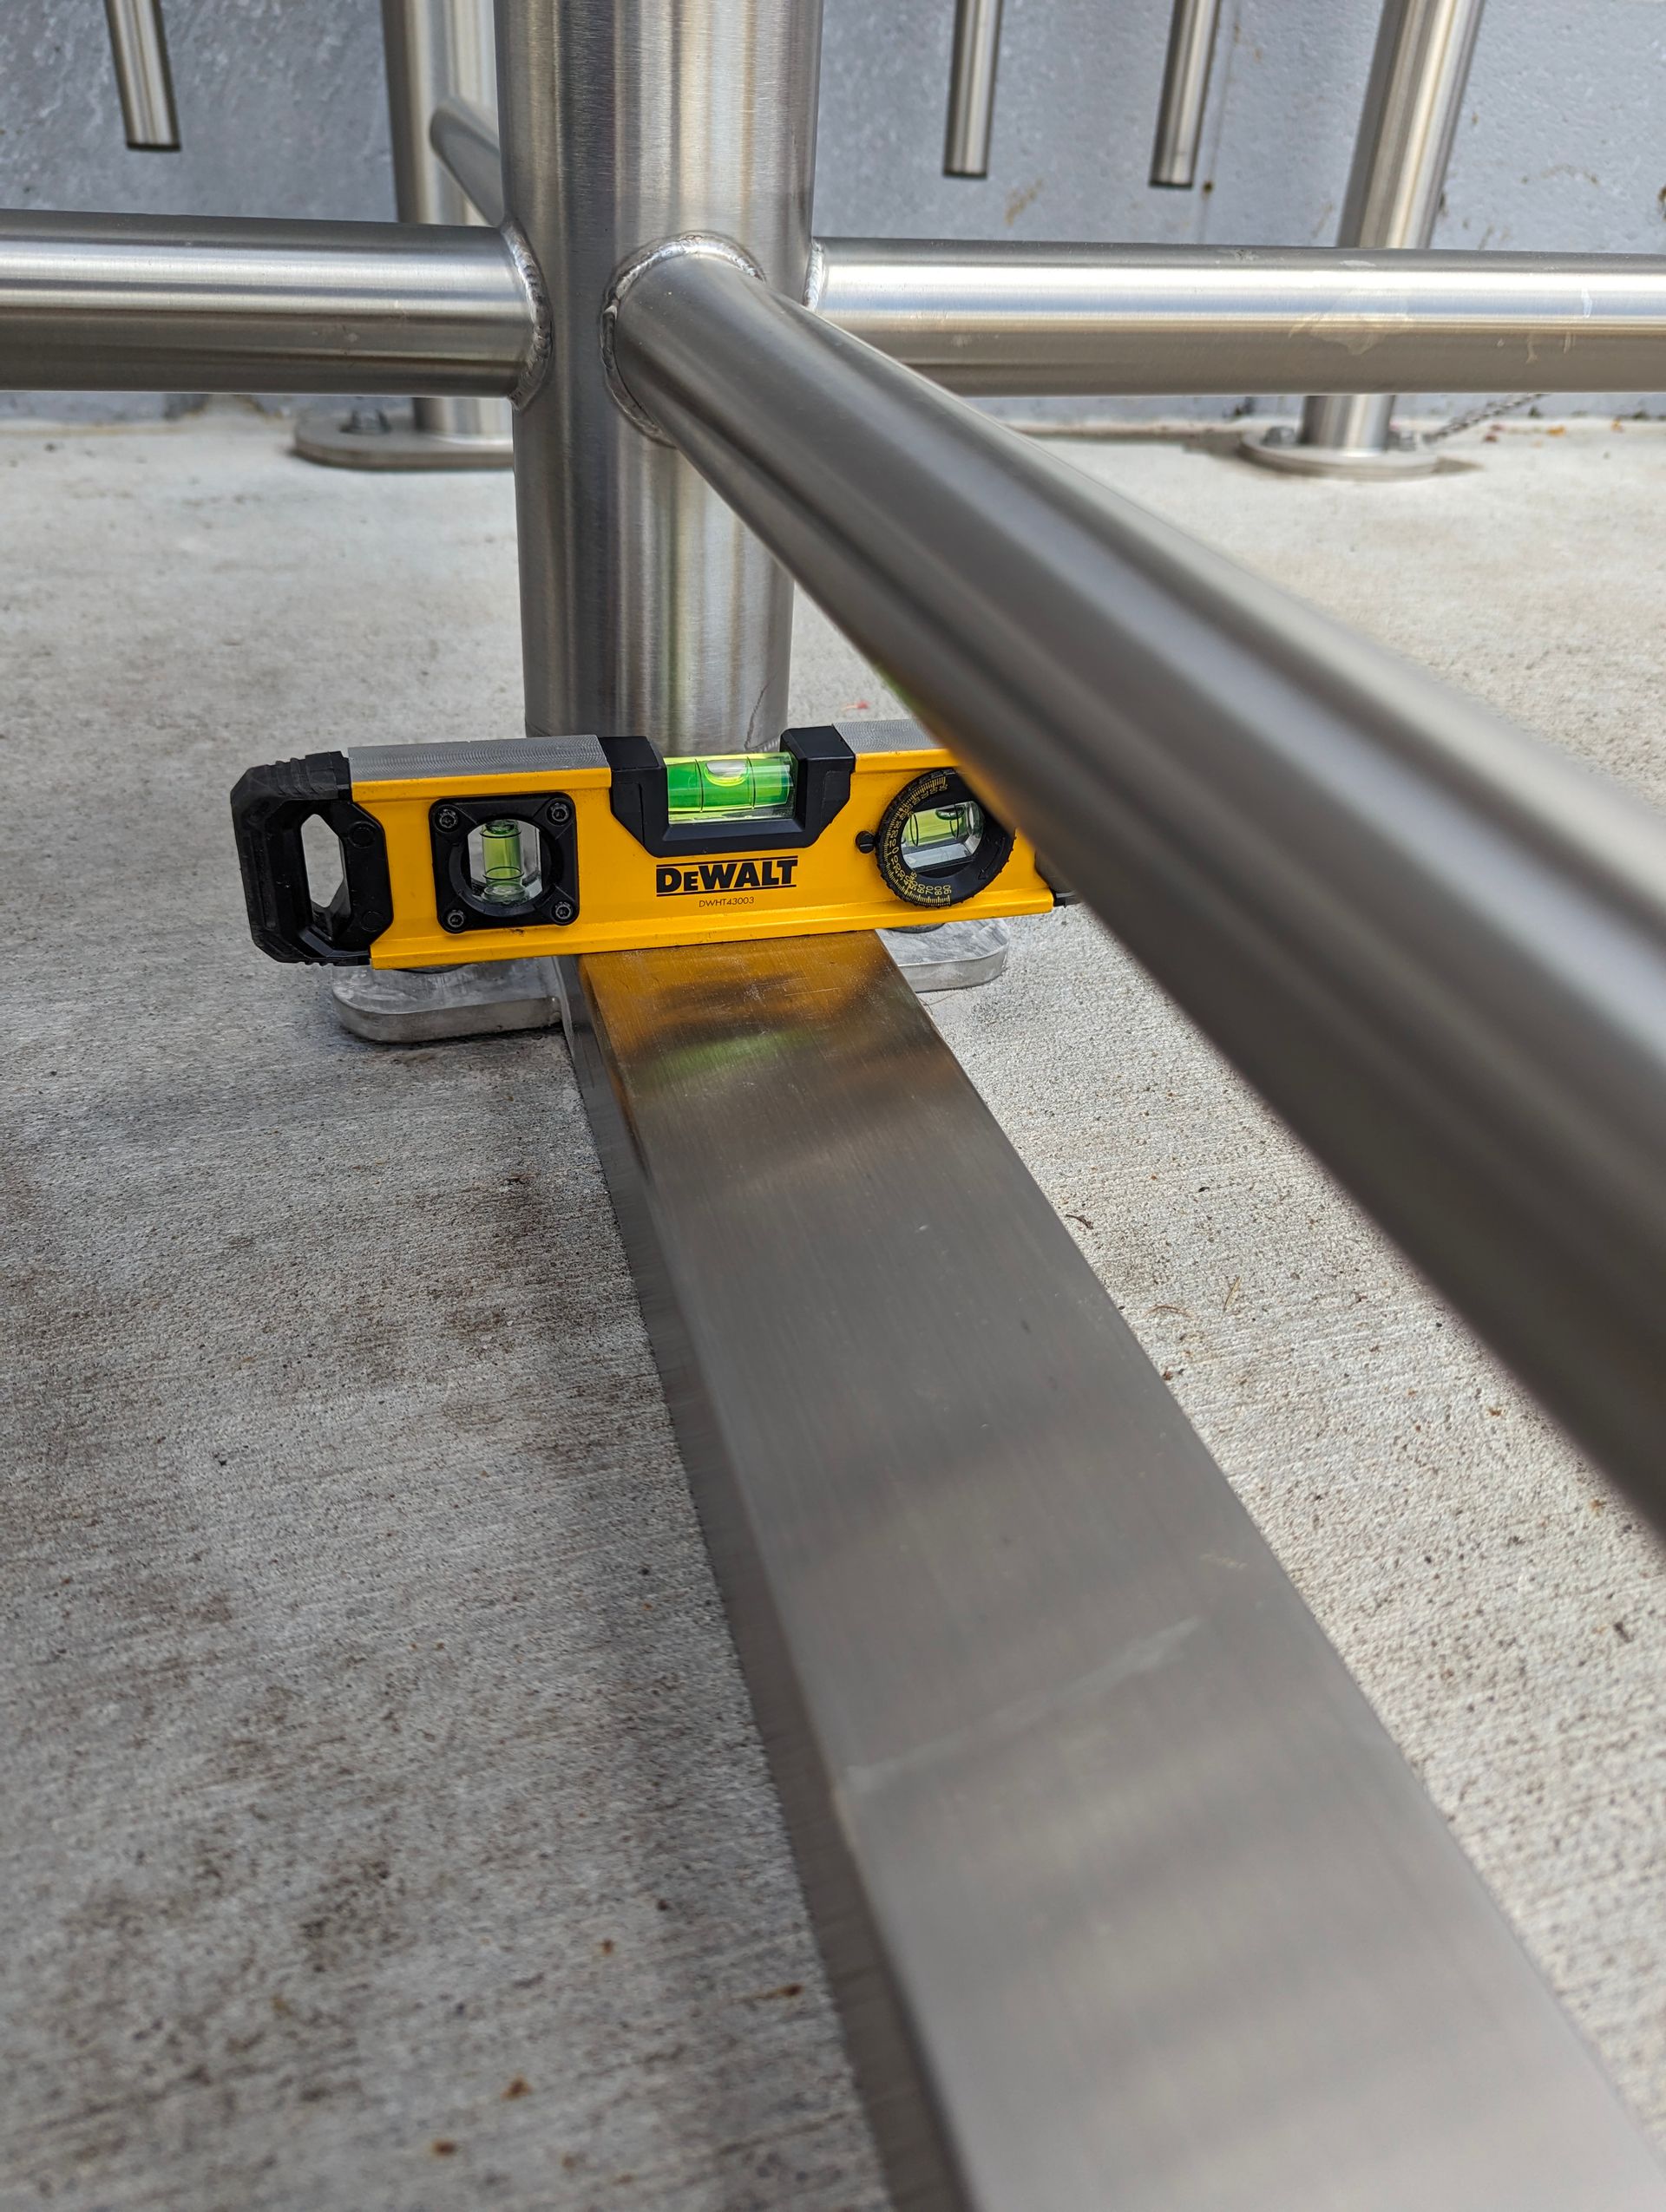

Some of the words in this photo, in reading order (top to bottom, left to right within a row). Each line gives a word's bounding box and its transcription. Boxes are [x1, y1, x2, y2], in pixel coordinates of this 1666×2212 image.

[889, 839, 896, 847] 10
[890, 855, 899, 865] 10
[893, 863, 901, 874] 20
[897, 870, 905, 880] 30
[917, 884, 926, 894] 60
[925, 886, 934, 895] 70
[935, 886, 942, 895] 80
[943, 885, 952, 894] 90
[699, 896, 755, 908] DWHT43003
